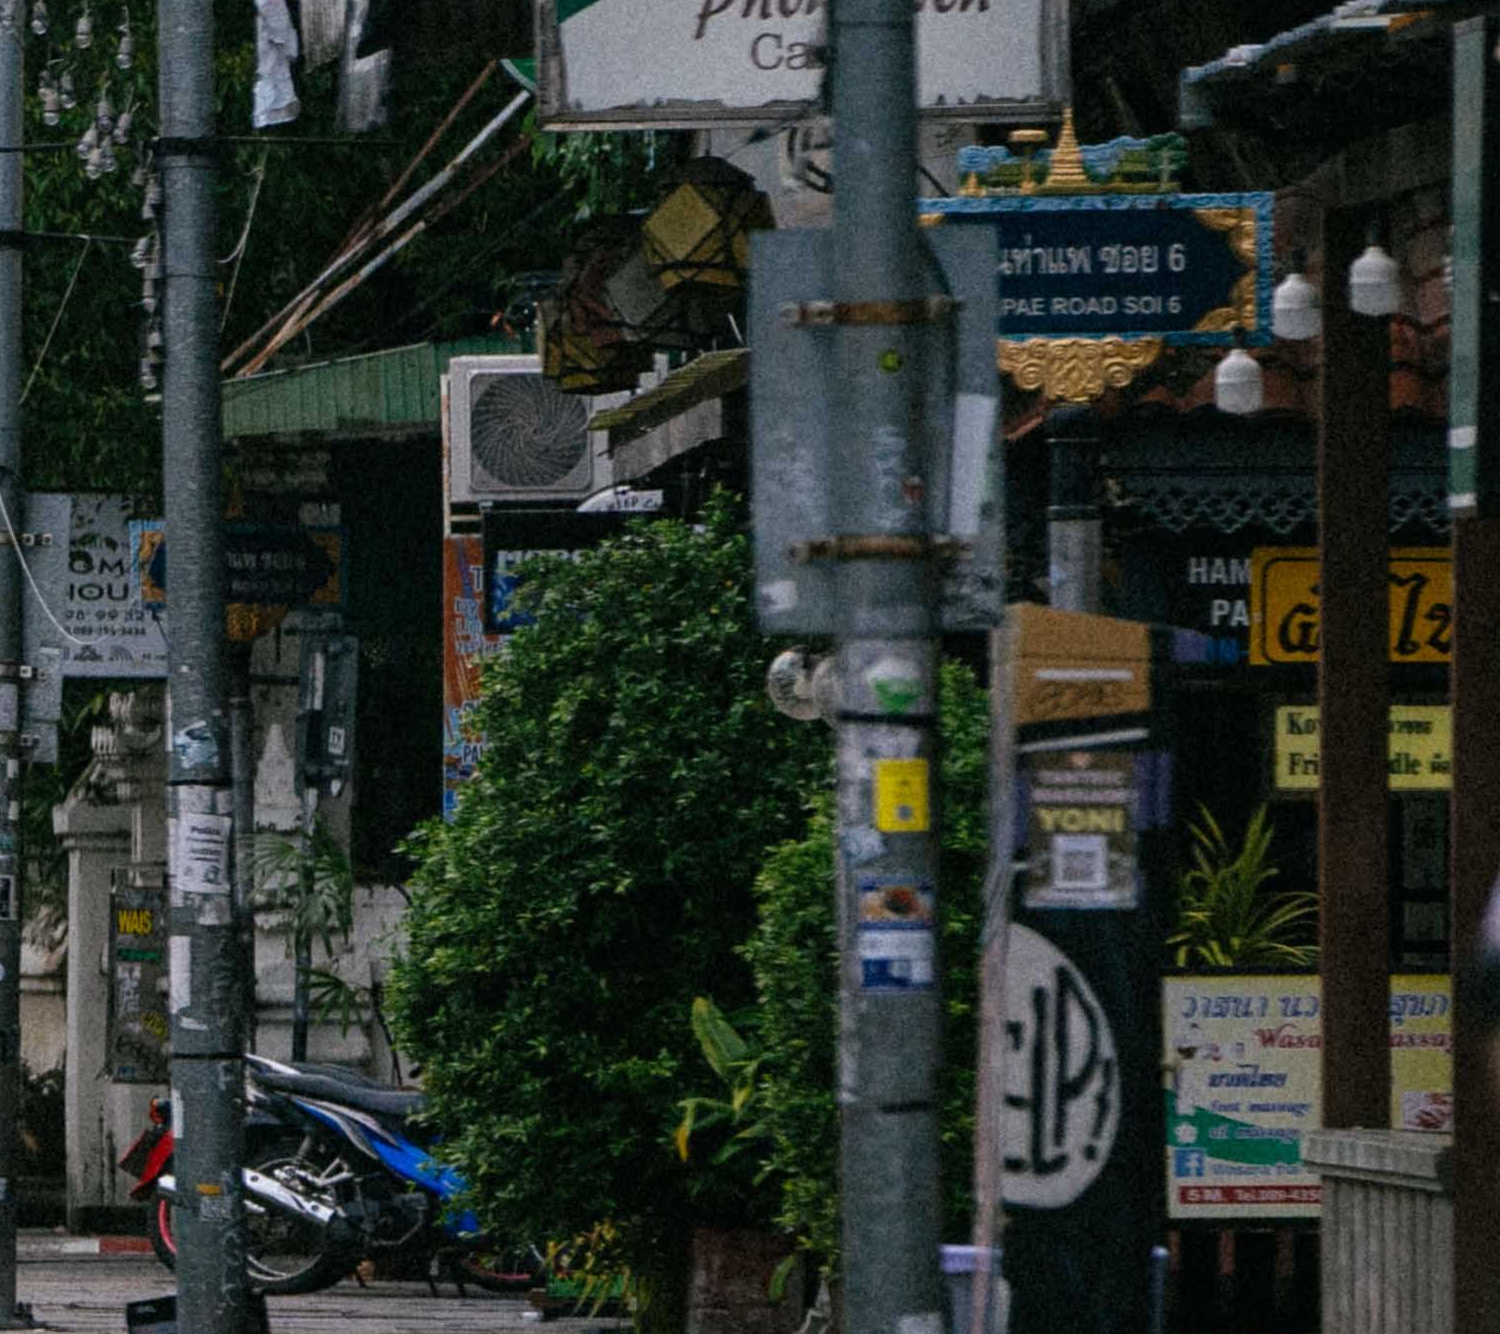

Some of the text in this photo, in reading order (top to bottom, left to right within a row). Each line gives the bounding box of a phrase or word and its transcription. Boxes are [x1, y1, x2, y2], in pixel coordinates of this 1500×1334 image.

[1099, 244, 1159, 274] ซอย
[1167, 243, 1187, 273] 6
[1000, 295, 1183, 316] PAE ROAD SOI 6
